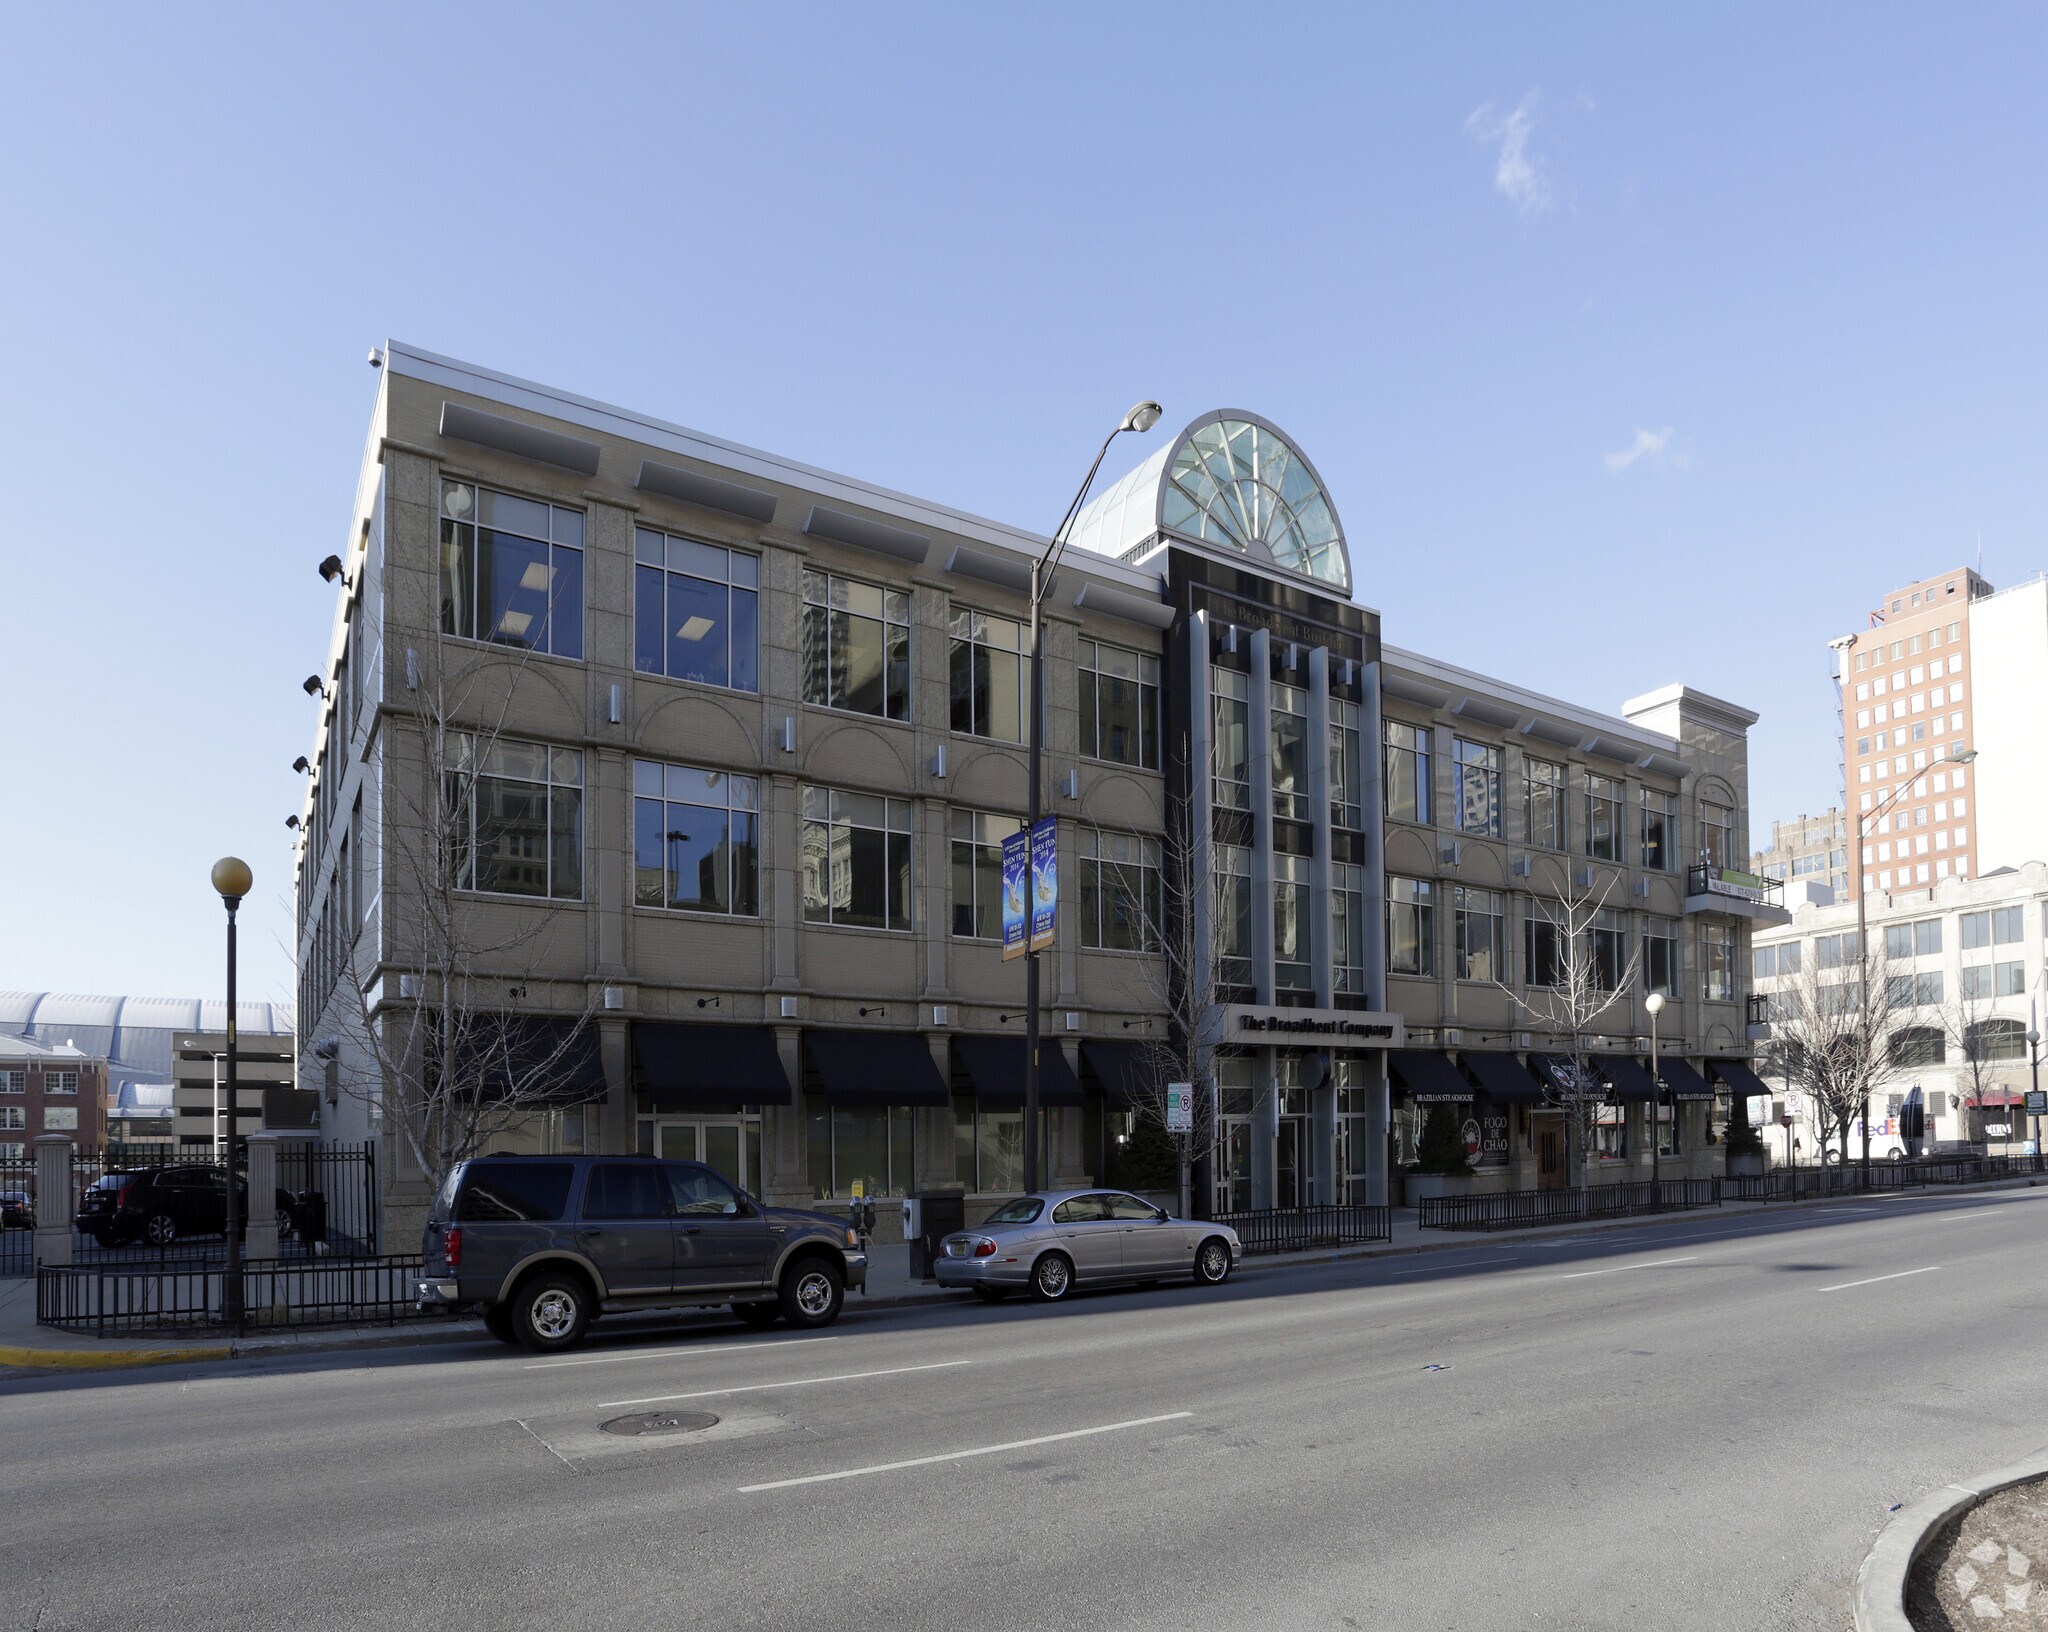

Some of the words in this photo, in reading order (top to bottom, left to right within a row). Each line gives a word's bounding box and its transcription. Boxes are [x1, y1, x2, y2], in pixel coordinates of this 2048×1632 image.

[1240, 1014, 1266, 1031] The
[1267, 1016, 1337, 1034] Broadbent
[1339, 1020, 1394, 1039] Company
[1484, 1117, 1507, 1128] FOGO
[1857, 1119, 1900, 1137] FedE
[1491, 1129, 1500, 1138] DE
[1484, 1139, 1508, 1151] CHÃO
